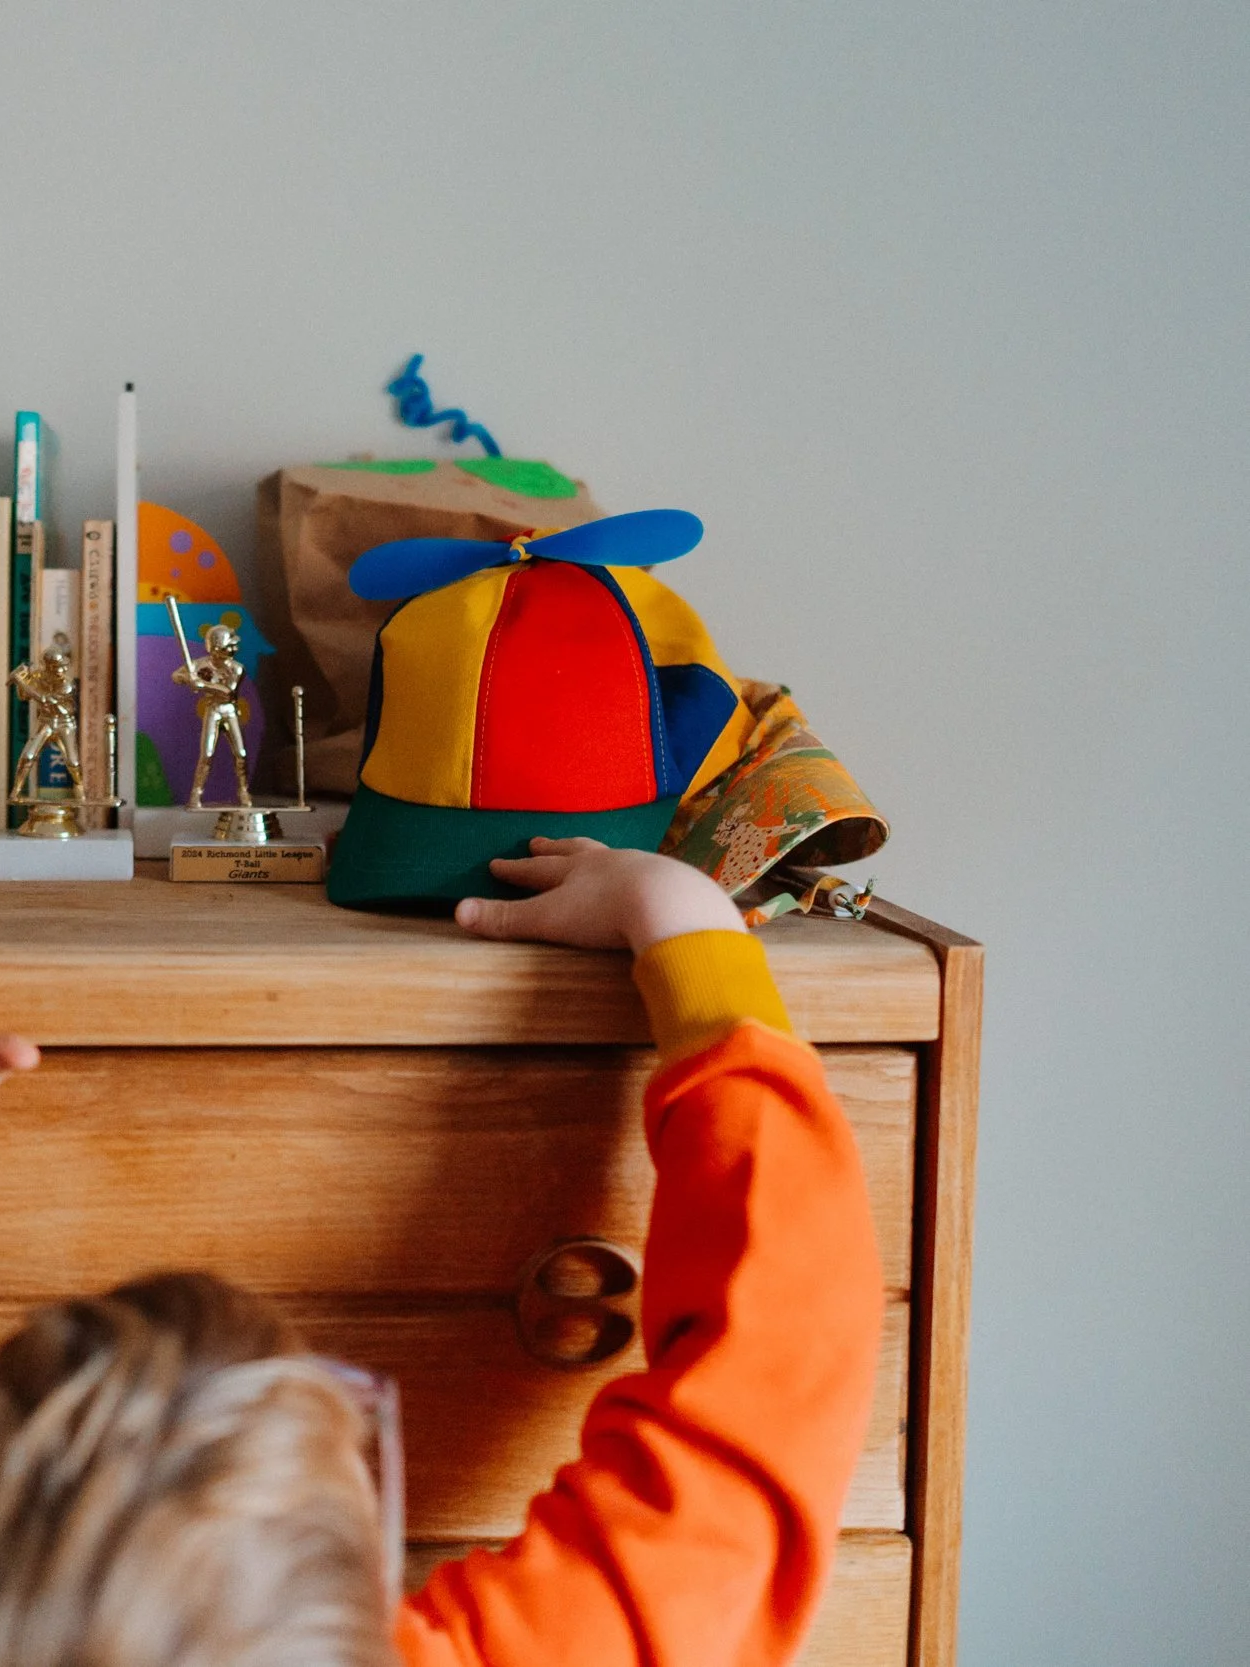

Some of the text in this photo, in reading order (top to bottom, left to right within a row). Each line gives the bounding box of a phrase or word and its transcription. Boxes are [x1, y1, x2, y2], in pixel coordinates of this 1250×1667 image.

[181, 849, 314, 861] 2024 Richmond Little League
[234, 860, 261, 868] T-Ball
[228, 869, 270, 879] Giants
